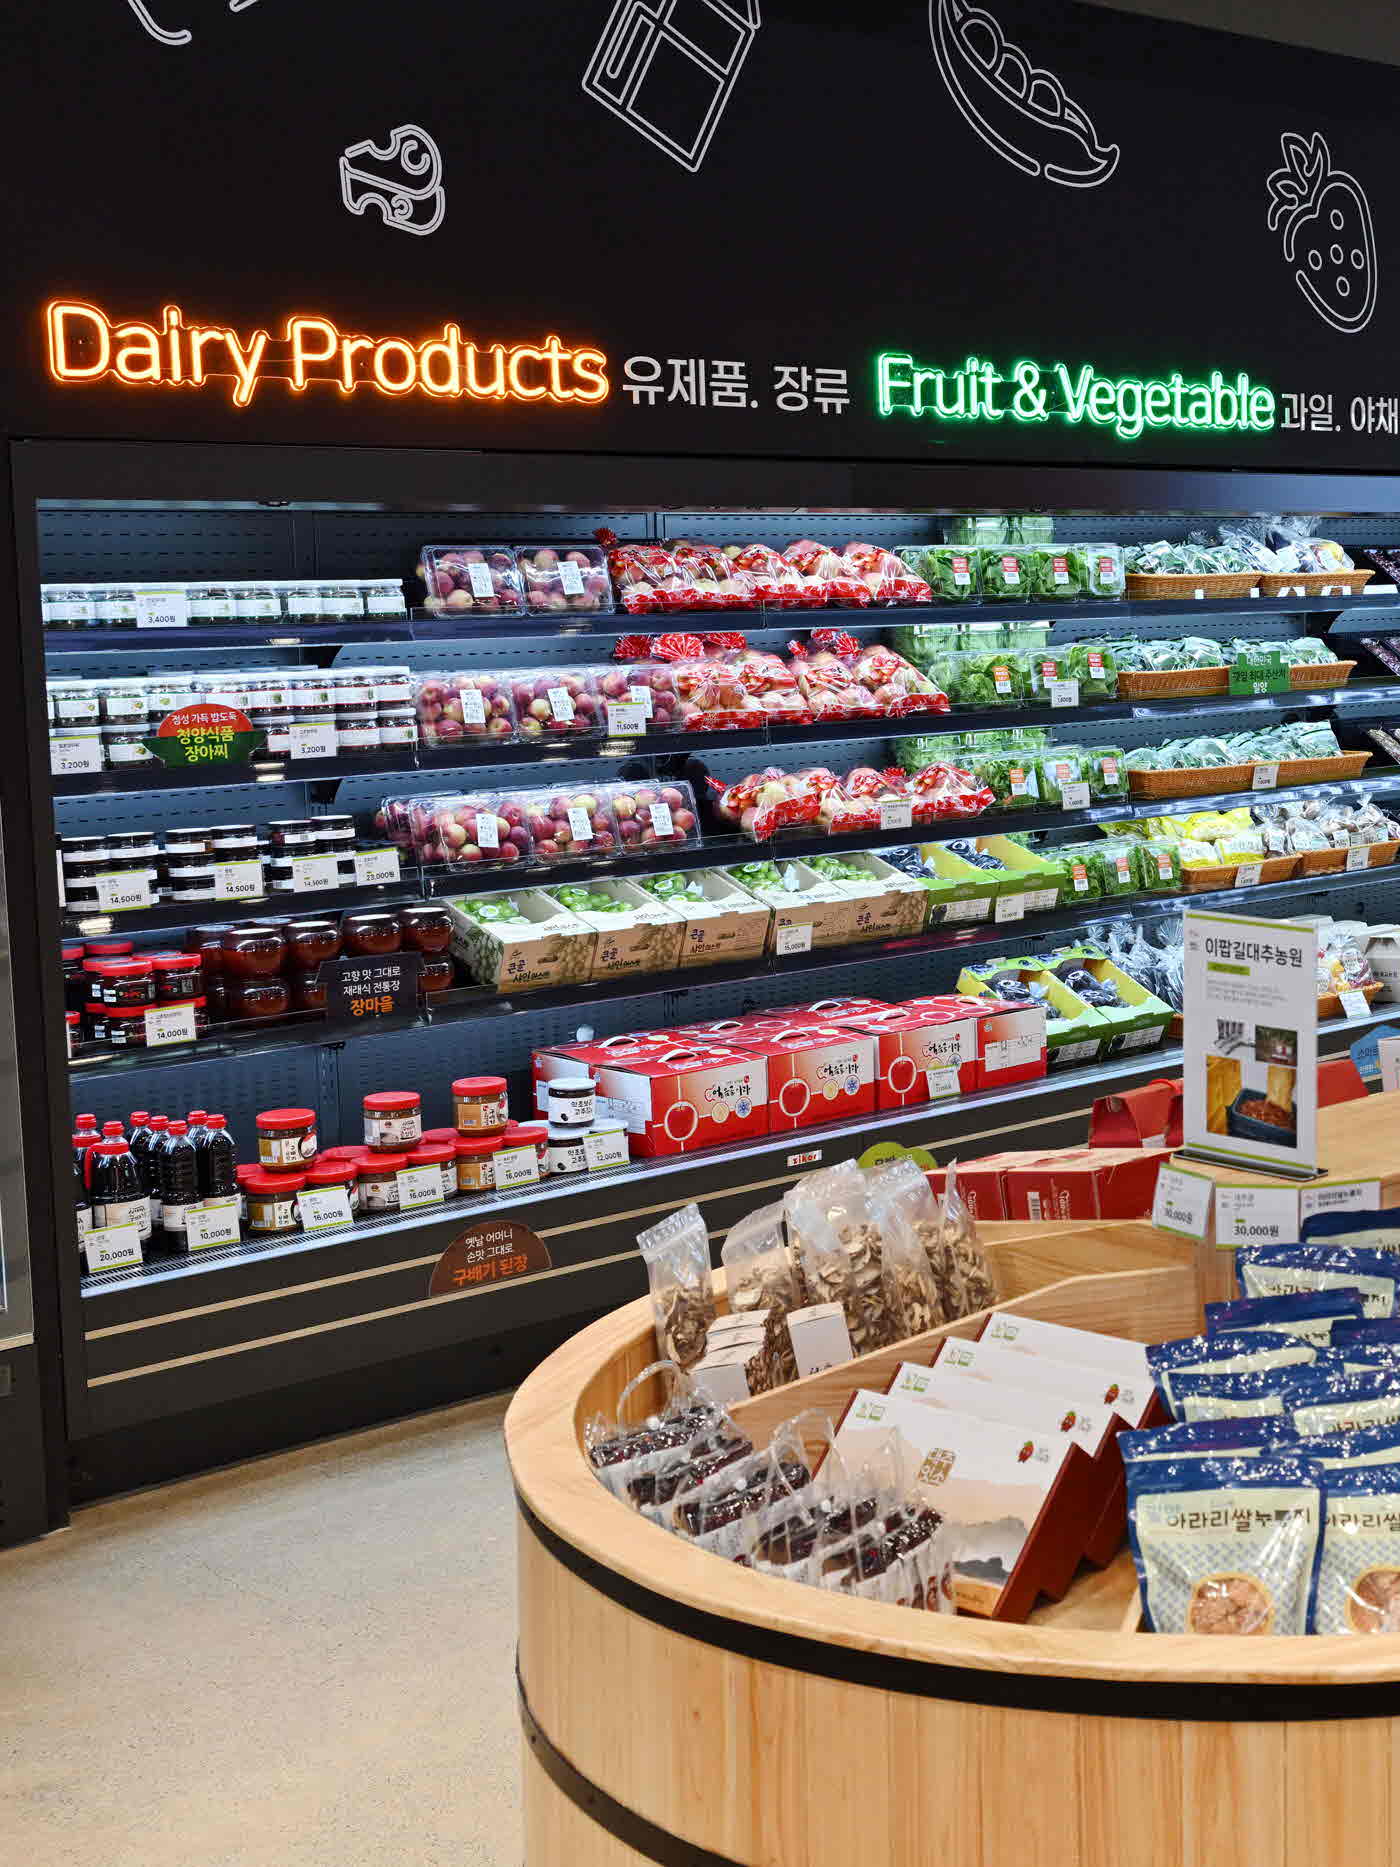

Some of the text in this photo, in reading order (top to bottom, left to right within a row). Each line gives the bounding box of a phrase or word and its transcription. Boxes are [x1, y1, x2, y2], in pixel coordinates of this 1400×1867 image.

[45, 299, 609, 405] Dairy Products
[622, 354, 851, 414] 유제품. 장류
[878, 353, 1276, 438] Fruit & Vegetable
[1280, 393, 1399, 435] 과일. 야채
[147, 615, 176, 625] 3,400원
[171, 711, 237, 726] 정성 가득 밥도둑
[176, 725, 235, 745] 청양식품
[184, 743, 229, 763] 장아찌
[301, 744, 326, 755] 3,200원
[60, 758, 90, 770] 3,200원
[366, 871, 395, 881] 23,000원
[225, 884, 256, 895] 14,500원
[110, 894, 142, 904] 14,500원
[1205, 937, 1304, 968] 이팝길대추농원
[341, 965, 400, 982] 고향 맛 그대로
[343, 979, 400, 996] 재래식 전통장
[350, 995, 394, 1017] 장마을
[156, 1028, 189, 1040] 14,000원
[596, 1151, 623, 1161] 12,000원
[505, 1168, 533, 1180] 16,000원
[409, 1188, 437, 1200] 16,000원
[313, 1210, 344, 1221] 16,000원
[199, 1227, 233, 1241] 10,000원
[1232, 1224, 1280, 1238] 30,000원
[465, 1228, 513, 1250] 옛날 어머니
[99, 1247, 135, 1262] 20,000원
[466, 1242, 513, 1264] 손맛 그대로
[452, 1256, 529, 1288] 구배기 된장
[1166, 1507, 1311, 1533] 아라리쌀누룽지
